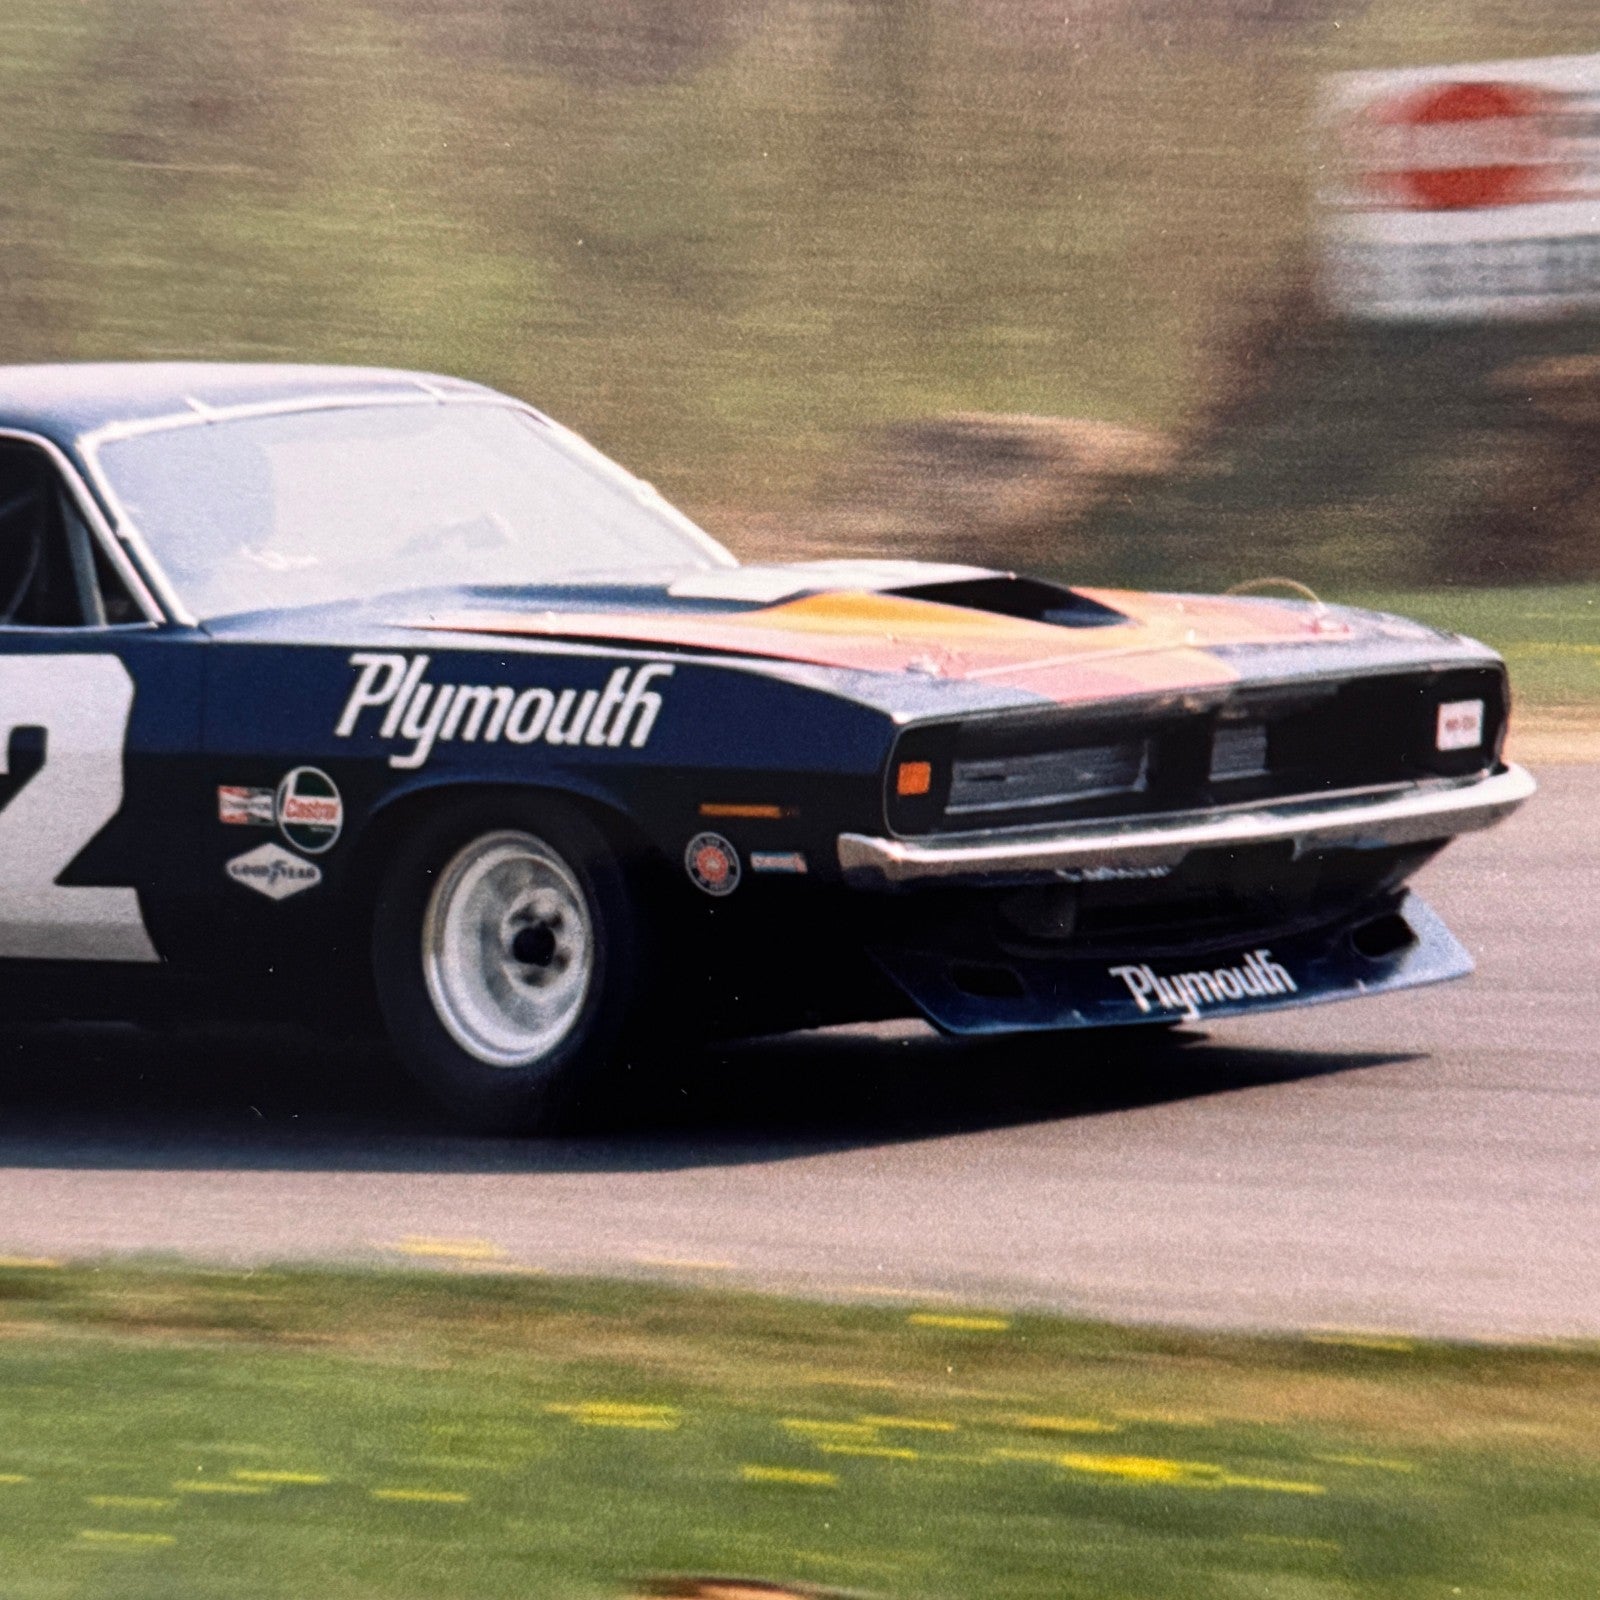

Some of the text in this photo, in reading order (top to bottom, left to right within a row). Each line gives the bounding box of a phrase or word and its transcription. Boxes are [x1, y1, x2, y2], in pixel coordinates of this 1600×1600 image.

[334, 652, 676, 769] Plymouth
[0, 653, 162, 963] 2
[1107, 948, 1299, 1022] Plymouth
